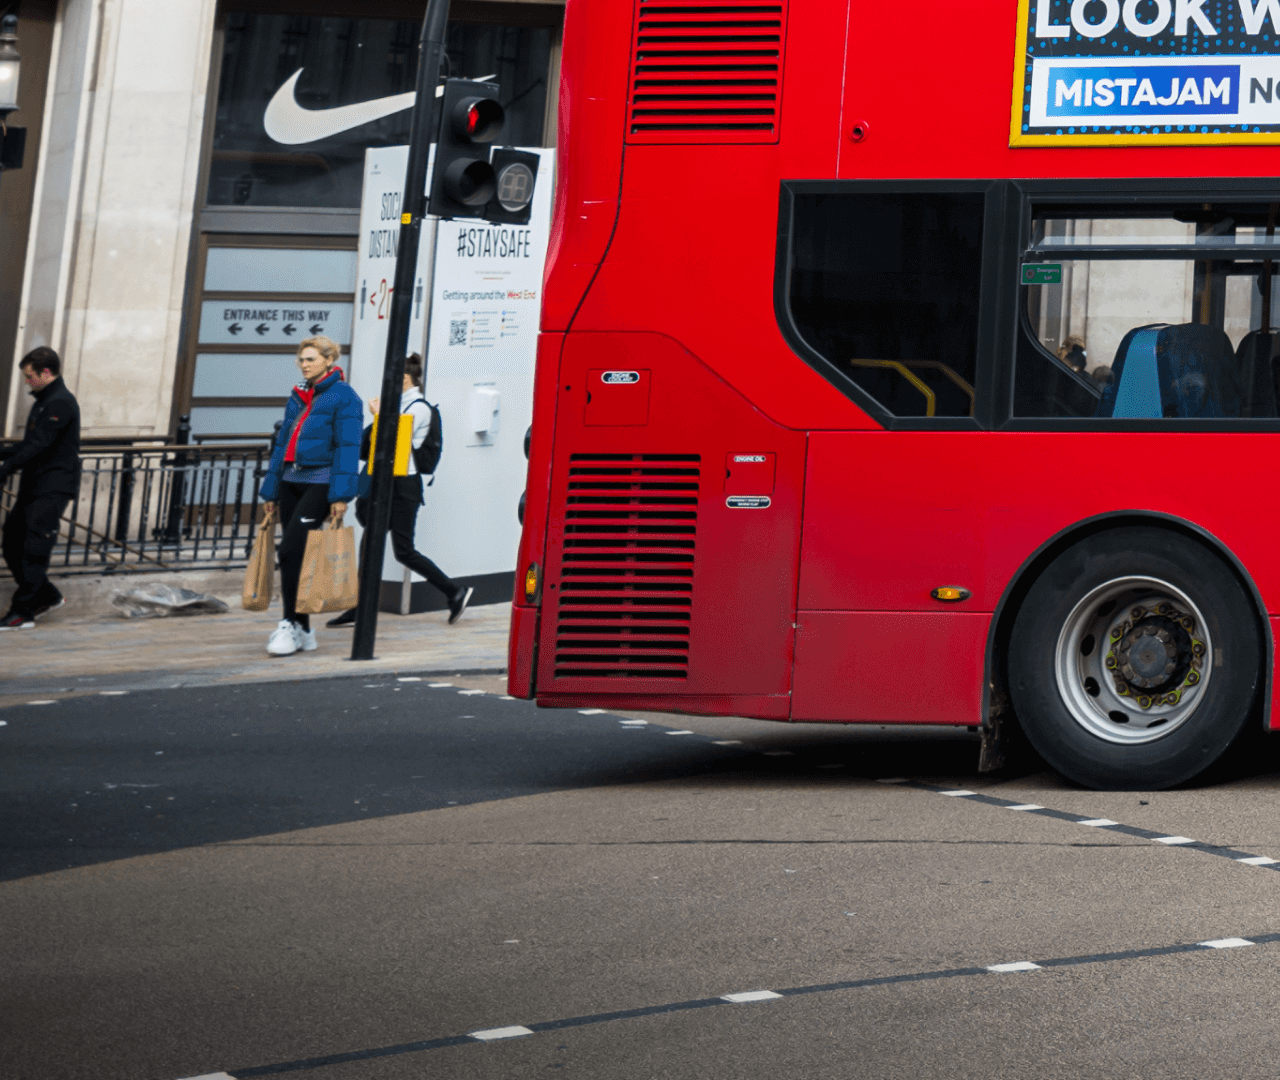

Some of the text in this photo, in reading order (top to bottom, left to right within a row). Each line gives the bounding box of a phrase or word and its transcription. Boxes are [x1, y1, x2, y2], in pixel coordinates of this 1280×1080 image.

[1054, 77, 1232, 108] MISTAJAM
[381, 191, 401, 221] SOCI
[369, 229, 400, 259] DISTAN
[457, 228, 531, 258] #STAYSAFE
[442, 289, 469, 304] Getting
[470, 290, 494, 301] around
[494, 289, 506, 301] the
[223, 308, 330, 321] ENTRANCE THIS WAY
